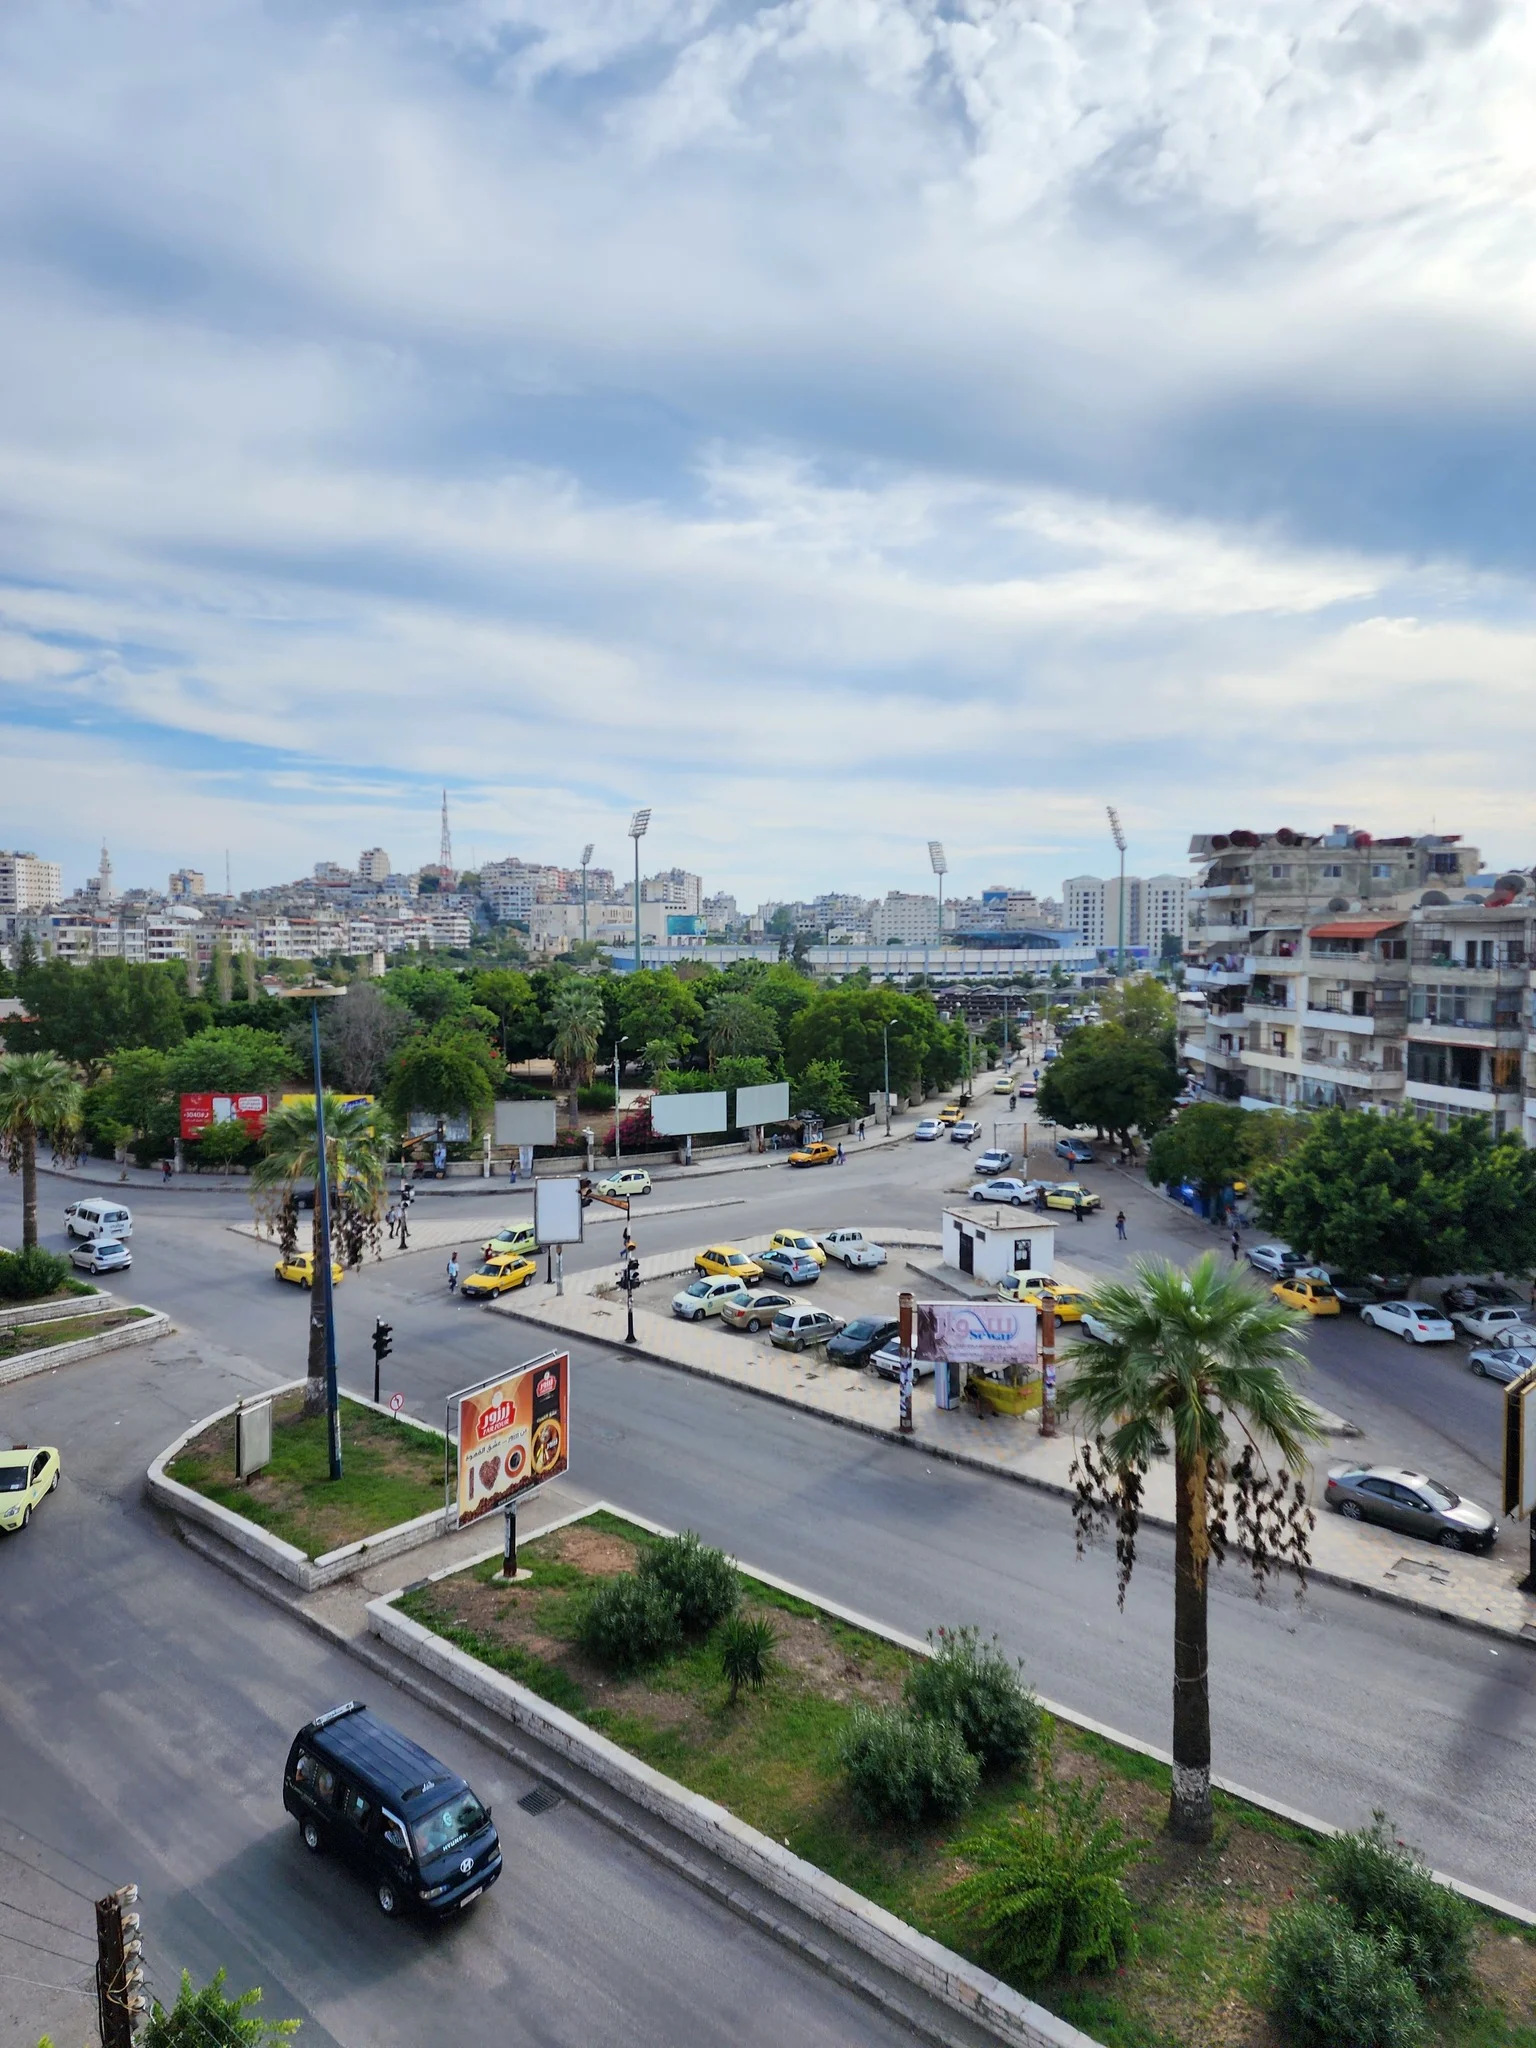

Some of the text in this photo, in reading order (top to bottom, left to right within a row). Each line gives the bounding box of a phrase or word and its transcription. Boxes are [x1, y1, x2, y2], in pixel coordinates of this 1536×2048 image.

[969, 1330, 1012, 1341] Sewar
[481, 1402, 511, 1430] زرزور
[482, 1418, 510, 1437] ZARZOUR
[442, 1832, 469, 1852] HYUNDAI
